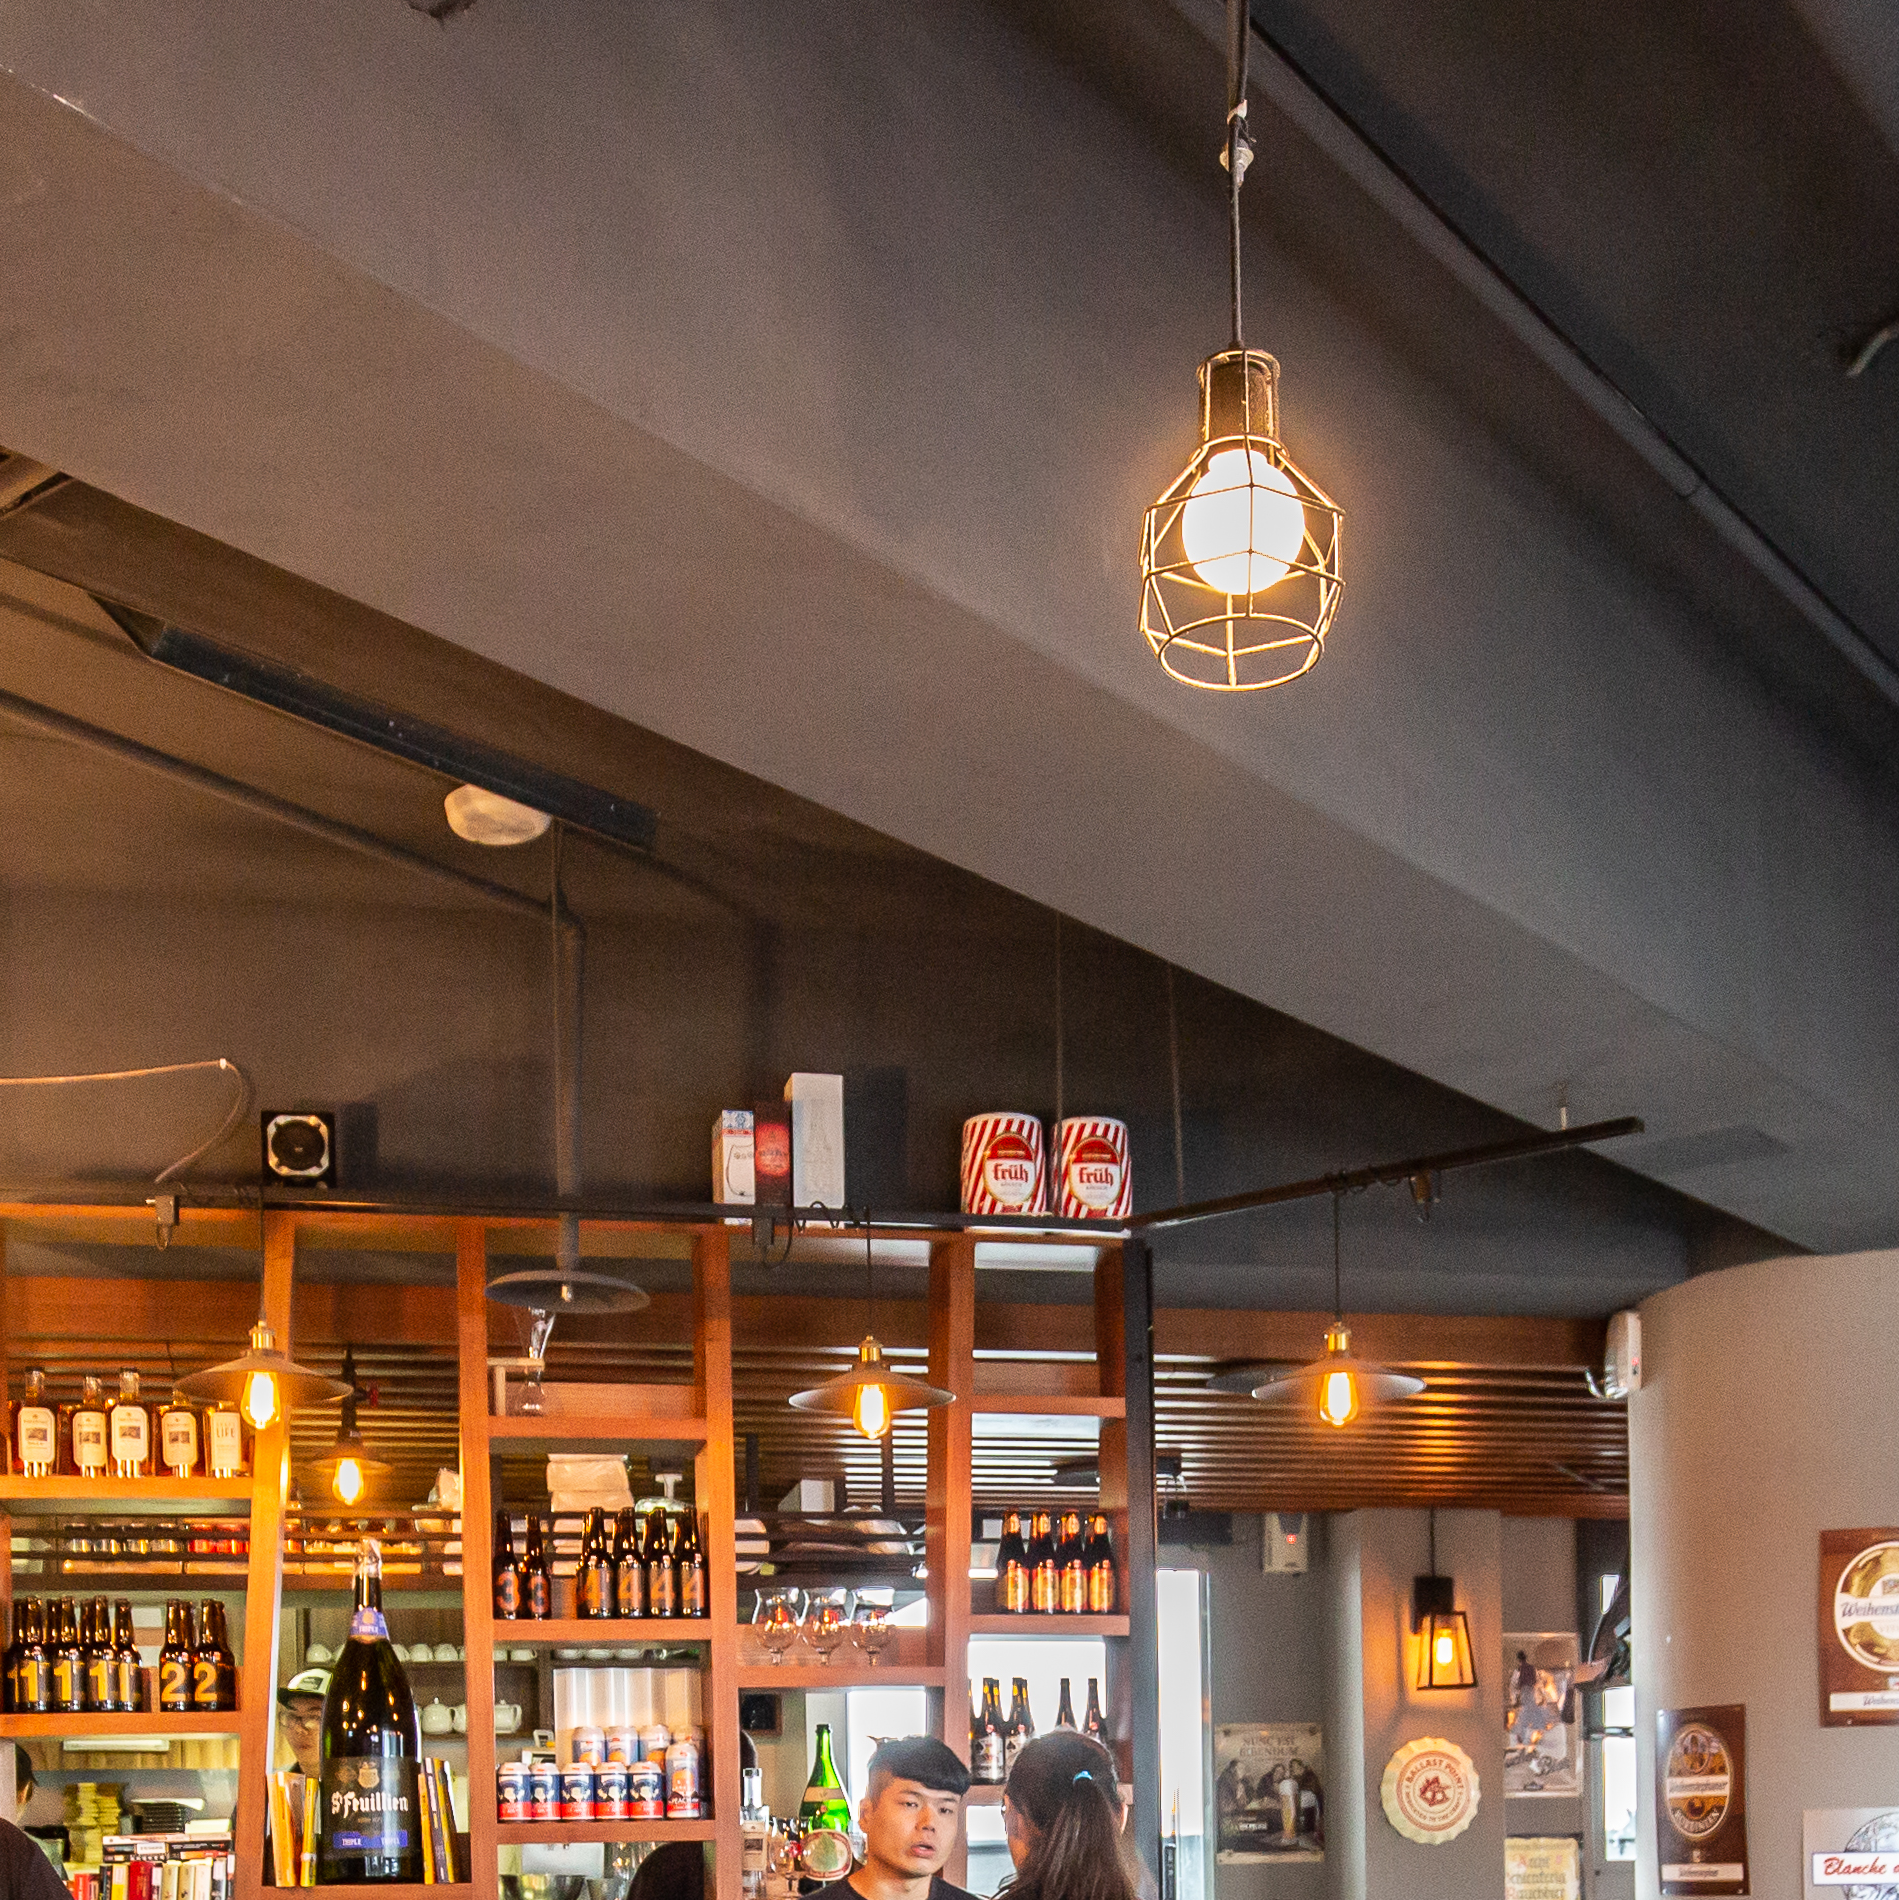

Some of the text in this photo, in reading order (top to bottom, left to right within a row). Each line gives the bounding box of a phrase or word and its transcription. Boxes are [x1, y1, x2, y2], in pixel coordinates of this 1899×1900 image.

[994, 1163, 1028, 1182] früh
[1079, 1167, 1113, 1187] früh
[496, 1570, 521, 1612] 3
[618, 1568, 642, 1608] 4
[651, 1568, 675, 1608] 4
[682, 1568, 704, 1608] 4
[20, 1660, 38, 1702] 1
[53, 1660, 72, 1702] 1
[89, 1660, 108, 1701] 1
[161, 1661, 186, 1702] 2
[193, 1661, 218, 1702] 2
[343, 1791, 409, 1818] Feuillien
[1823, 1856, 1887, 1876] Blanche
